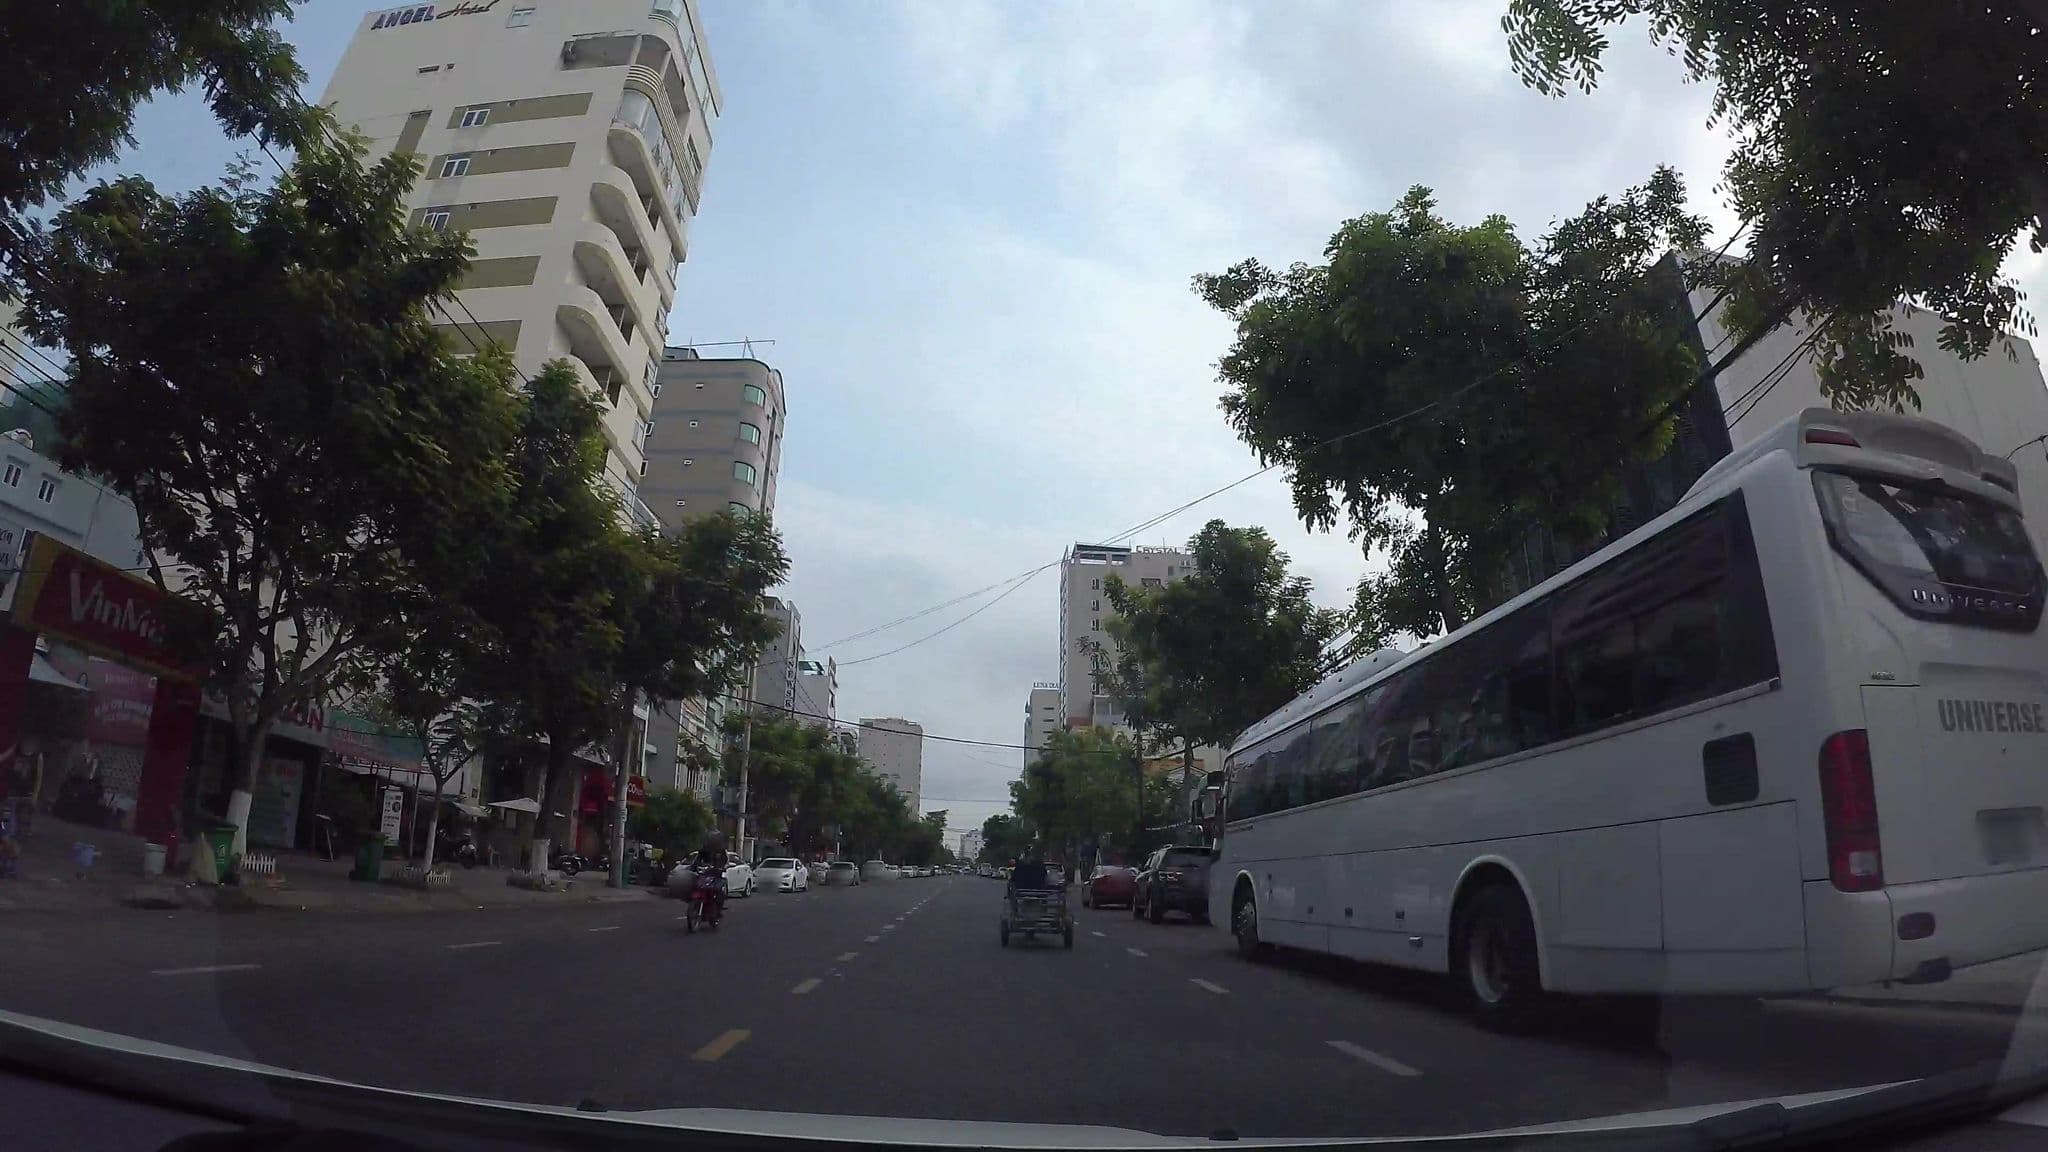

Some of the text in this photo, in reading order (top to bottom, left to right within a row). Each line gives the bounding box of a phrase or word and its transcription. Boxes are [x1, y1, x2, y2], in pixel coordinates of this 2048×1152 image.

[371, 5, 435, 30] ANGEL
[1136, 545, 1181, 554] CRYSTAL
[1938, 699, 2048, 733] UNIVERSE
